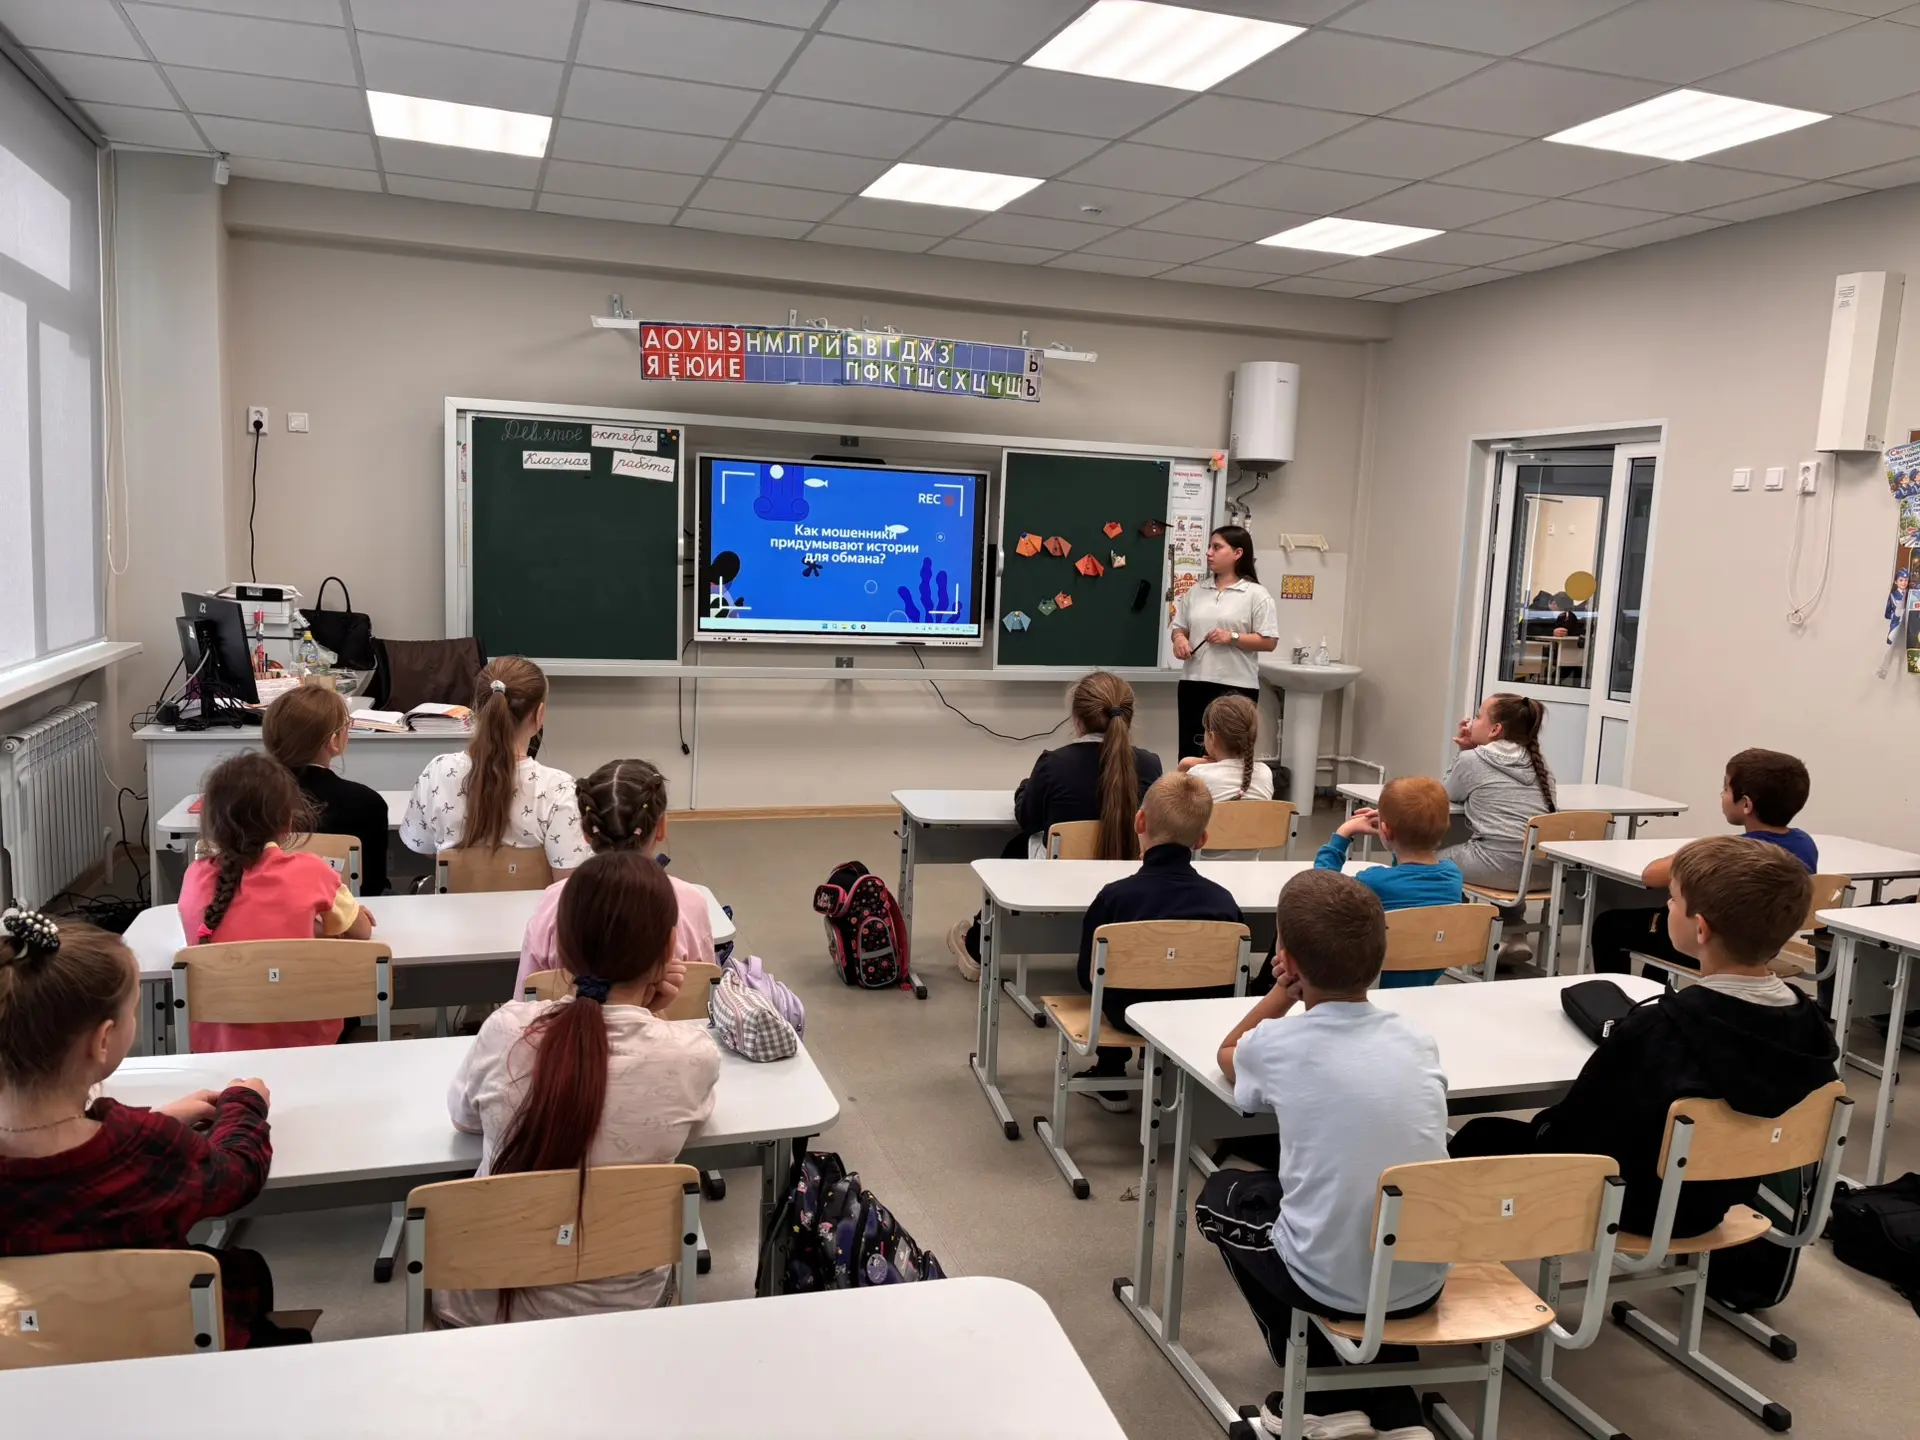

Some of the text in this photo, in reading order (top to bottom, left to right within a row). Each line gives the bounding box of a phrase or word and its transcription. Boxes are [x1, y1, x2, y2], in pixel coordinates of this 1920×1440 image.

[524, 452, 590, 466] Классная
[918, 493, 942, 505] REC
[794, 524, 897, 540] Как мошенники
[770, 537, 919, 555] придумывают истории
[804, 551, 886, 565] для обмана?
